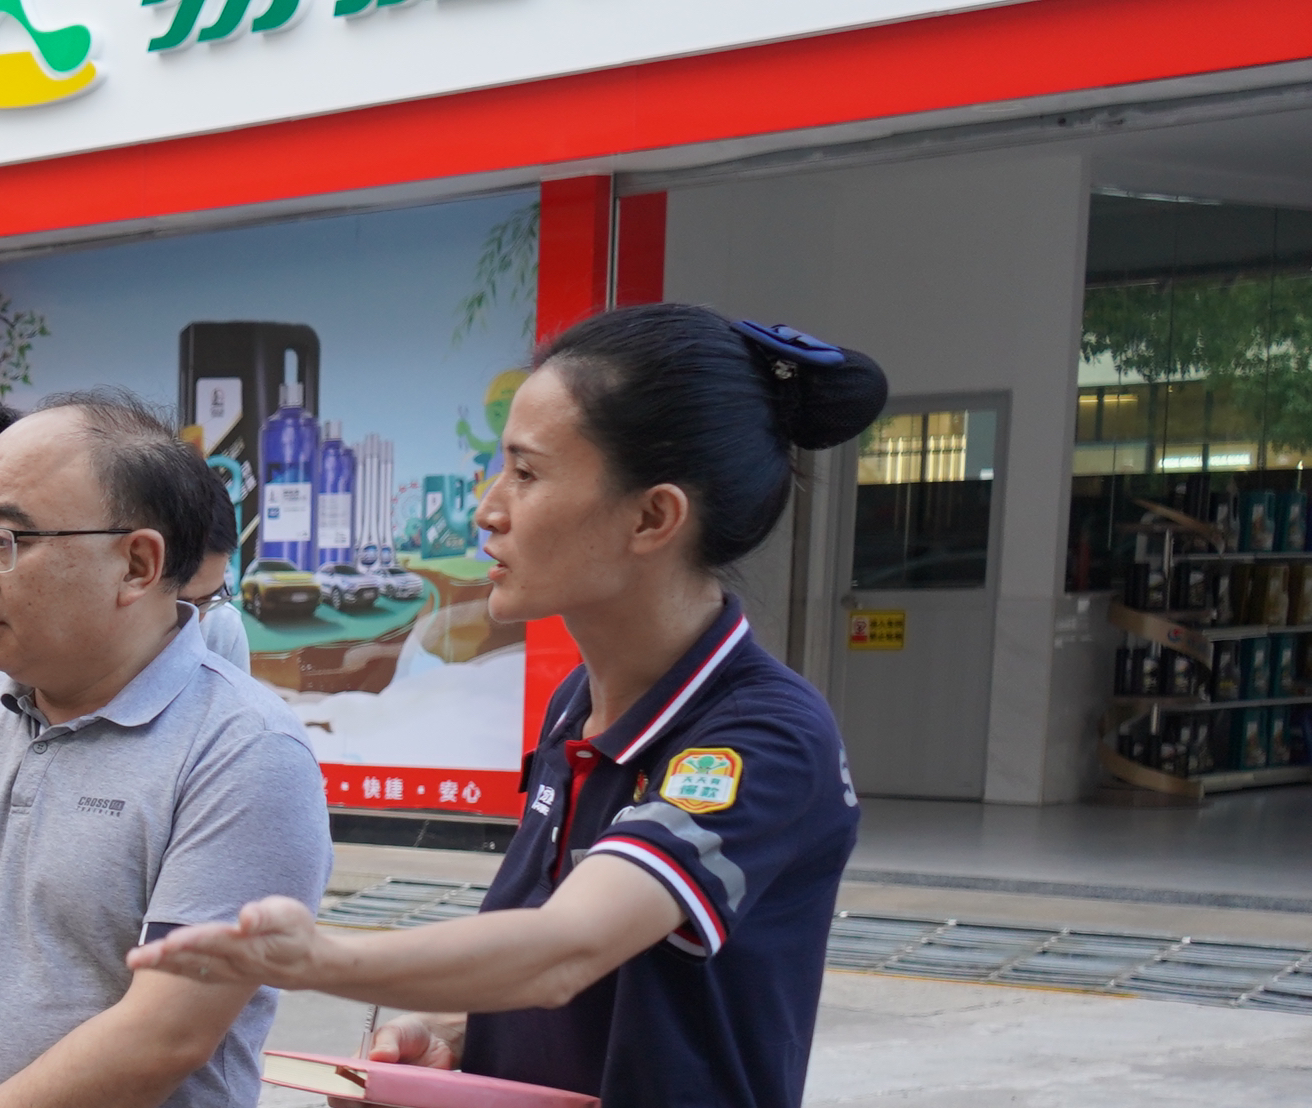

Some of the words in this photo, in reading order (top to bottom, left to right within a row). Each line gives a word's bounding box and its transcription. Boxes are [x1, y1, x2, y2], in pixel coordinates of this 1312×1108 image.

[362, 776, 404, 801] 快捷
[438, 779, 481, 804] 安心
[77, 796, 110, 809] CROSS
